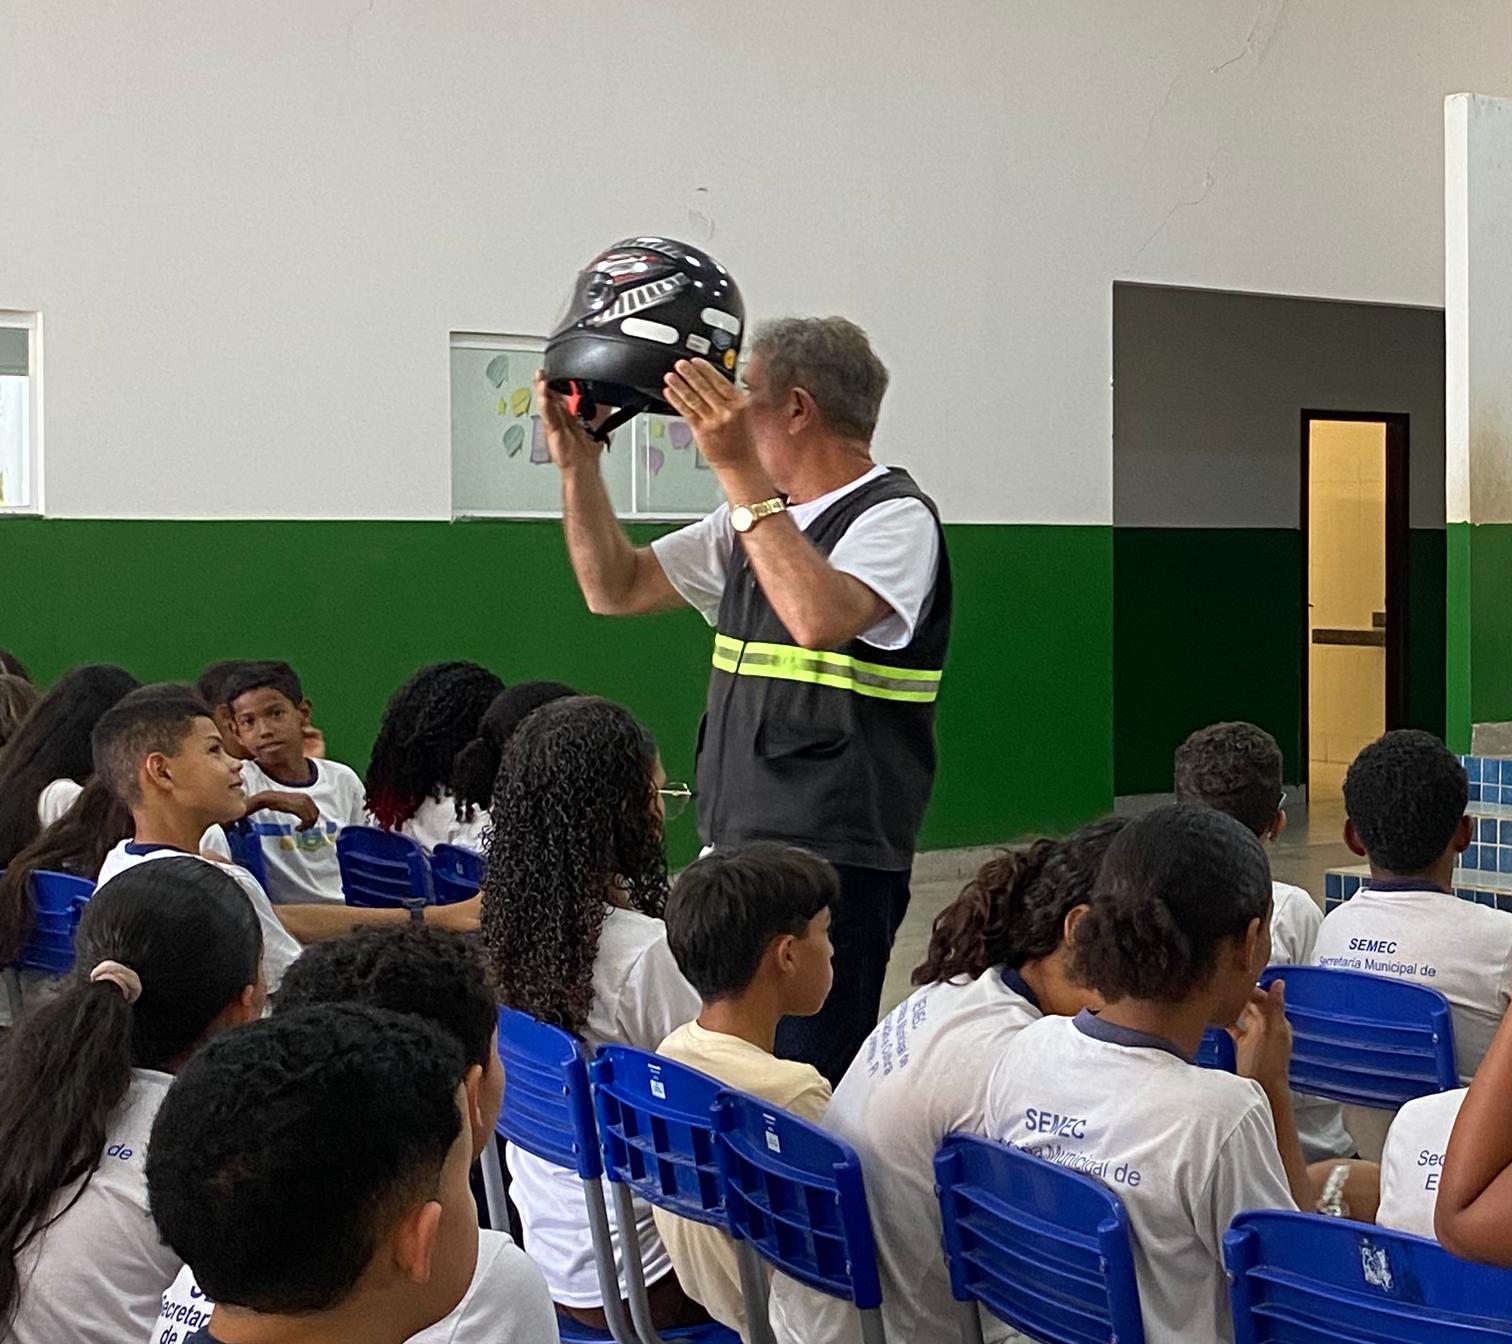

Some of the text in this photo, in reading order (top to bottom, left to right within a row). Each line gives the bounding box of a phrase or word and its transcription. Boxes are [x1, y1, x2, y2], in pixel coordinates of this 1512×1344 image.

[1349, 938, 1397, 954] SEMEC
[1365, 958, 1417, 975] Municipal
[1420, 965, 1436, 977] de
[1025, 1108, 1087, 1140] SEMEC
[108, 1144, 132, 1160] de
[1114, 1163, 1141, 1187] de
[161, 1295, 211, 1328] ecretar
